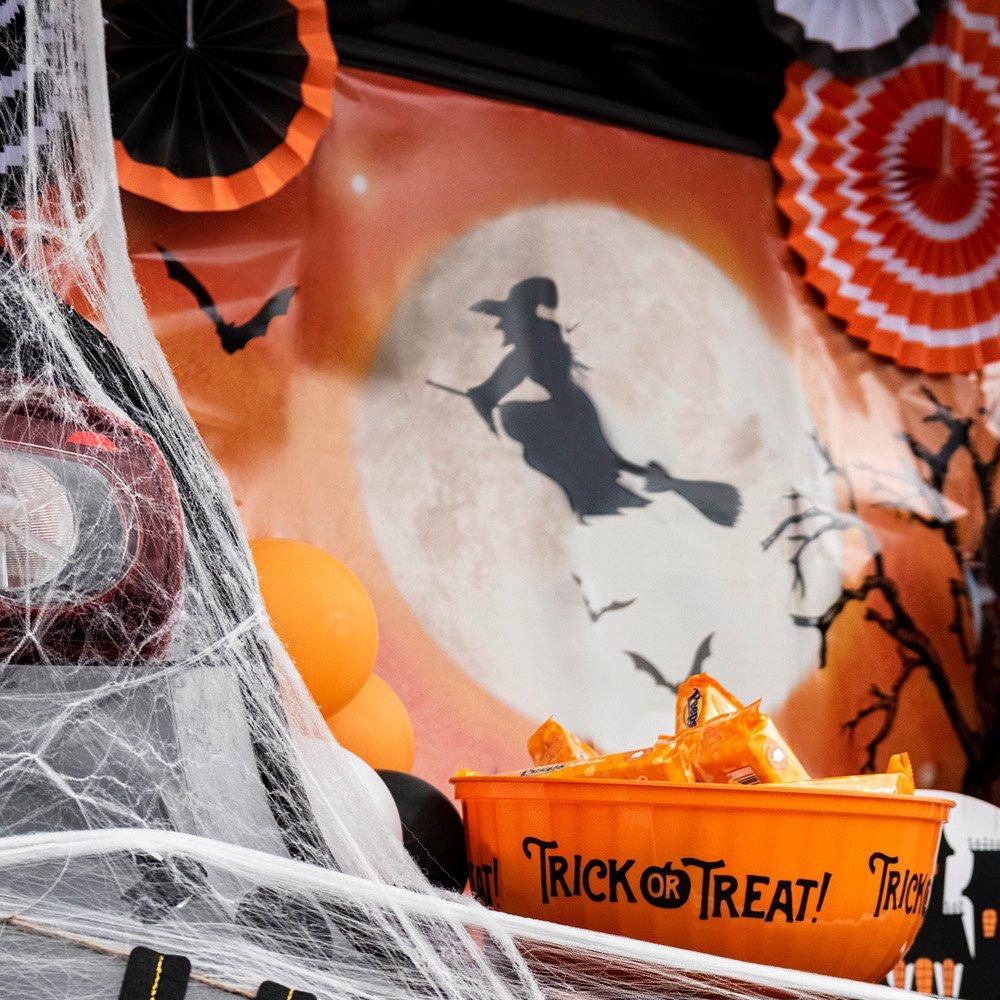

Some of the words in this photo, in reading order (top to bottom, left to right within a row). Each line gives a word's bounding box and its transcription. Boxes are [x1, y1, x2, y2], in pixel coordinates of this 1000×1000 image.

[521, 835, 638, 905] TRICK
[646, 872, 681, 900] OR
[680, 856, 833, 924] TREAT!
